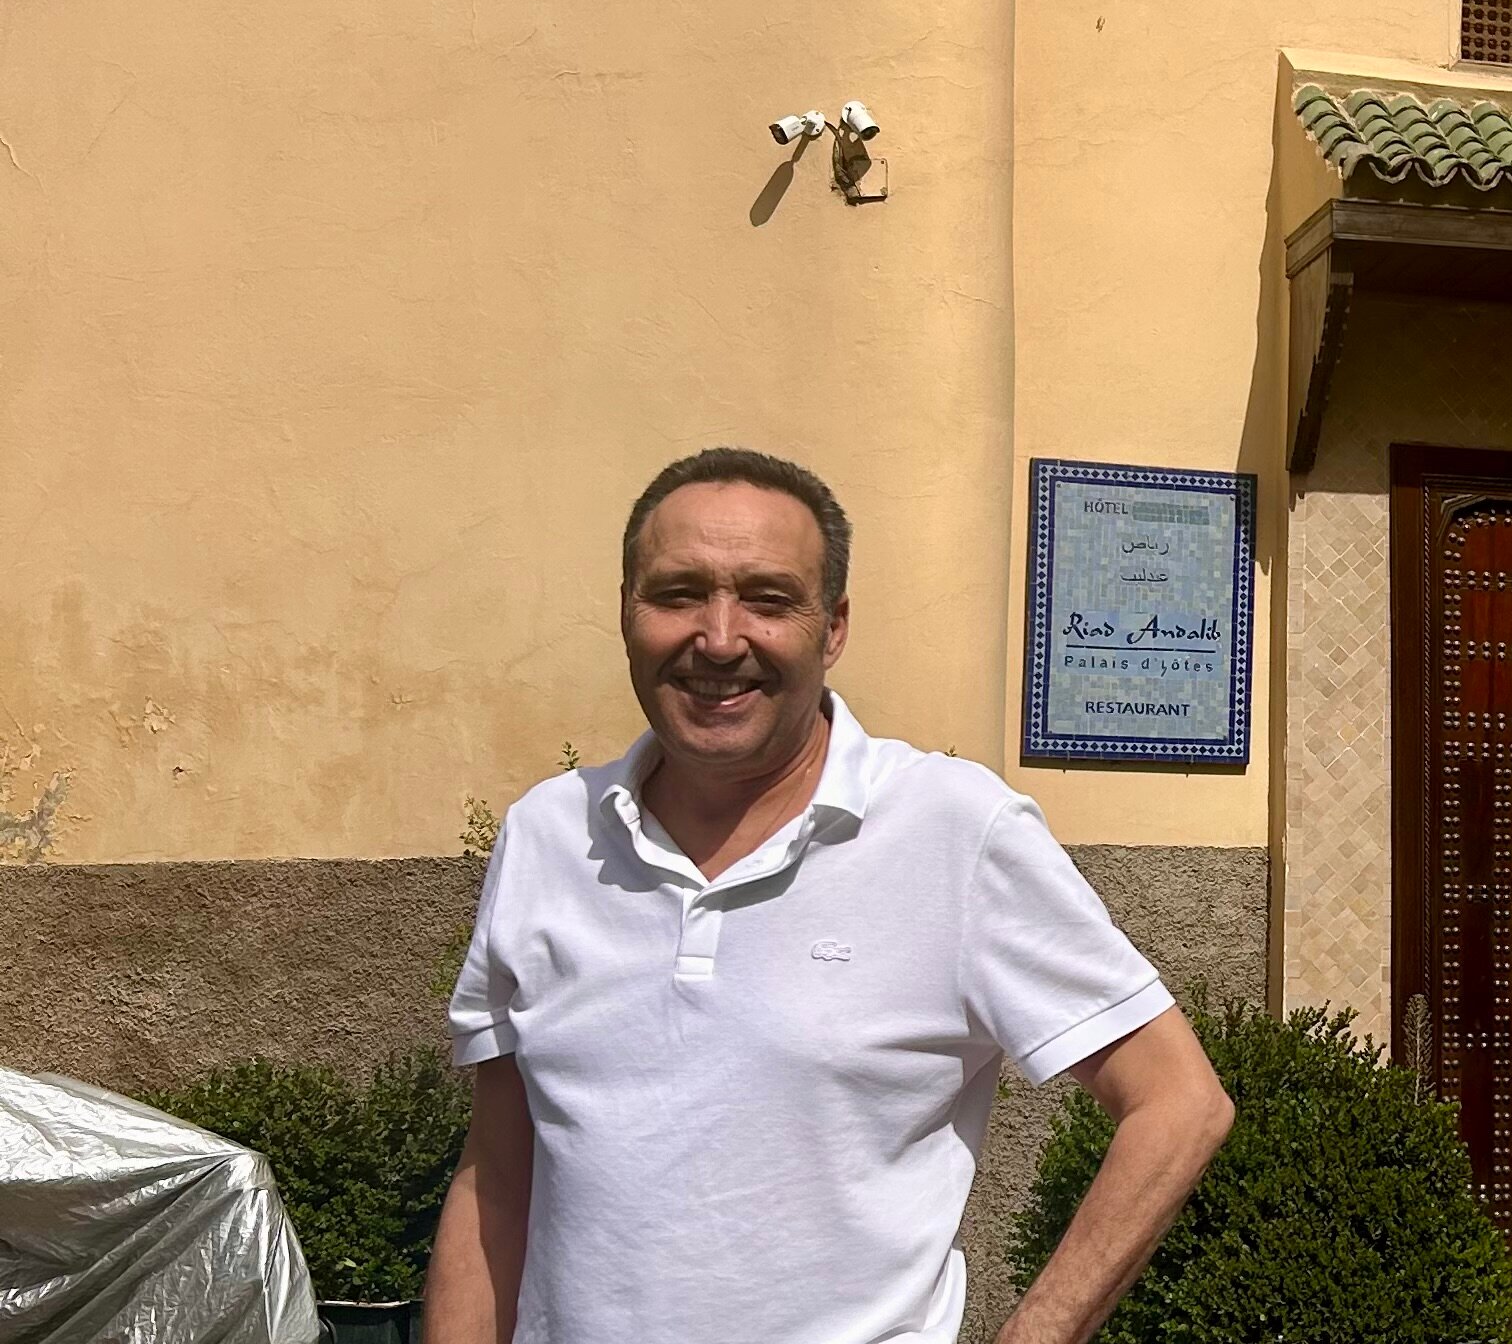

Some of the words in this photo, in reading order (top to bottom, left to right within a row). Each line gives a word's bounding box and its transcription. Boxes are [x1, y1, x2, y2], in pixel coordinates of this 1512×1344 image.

[1083, 498, 1129, 515] HÔTEL
[1062, 611, 1115, 640] Riad
[1126, 614, 1222, 644] Andalib
[1064, 656, 1129, 670] Palais
[1085, 701, 1191, 717] RESTAURANT
